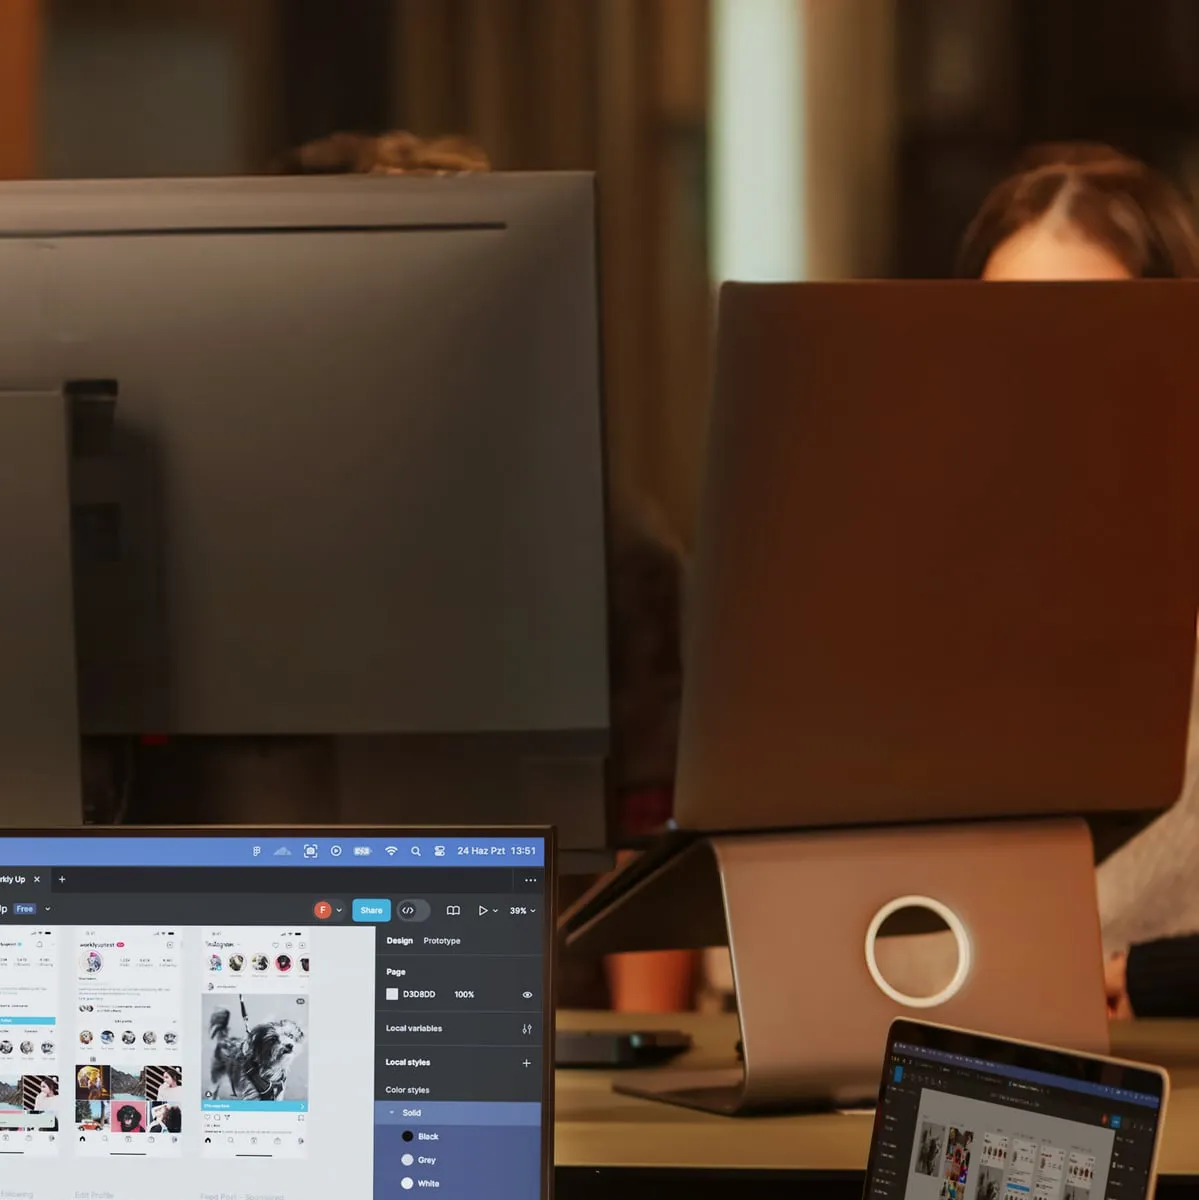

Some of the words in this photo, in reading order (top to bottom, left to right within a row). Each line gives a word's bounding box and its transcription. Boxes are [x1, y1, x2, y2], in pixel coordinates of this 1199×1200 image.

[457, 846, 469, 855] 24
[471, 846, 488, 855] Haz
[491, 846, 506, 855] Pzt
[511, 846, 536, 855] 13:51
[19, 876, 26, 884] Up
[16, 905, 33, 913] Free
[319, 906, 326, 914] F
[360, 906, 383, 914] Share
[510, 907, 527, 915] 39%
[386, 937, 413, 946] Design
[423, 937, 461, 946] Prototype
[386, 968, 406, 977] Page
[454, 990, 474, 998] 100%
[386, 1024, 406, 1032] Local
[408, 1024, 443, 1032] variables
[385, 1058, 406, 1066] Local
[407, 1058, 431, 1067] styles
[385, 1086, 405, 1094] Color
[407, 1086, 430, 1095] styles
[402, 1109, 421, 1117] Solid
[418, 1132, 439, 1141] Black
[418, 1156, 436, 1166] Grey
[418, 1179, 440, 1188] White
